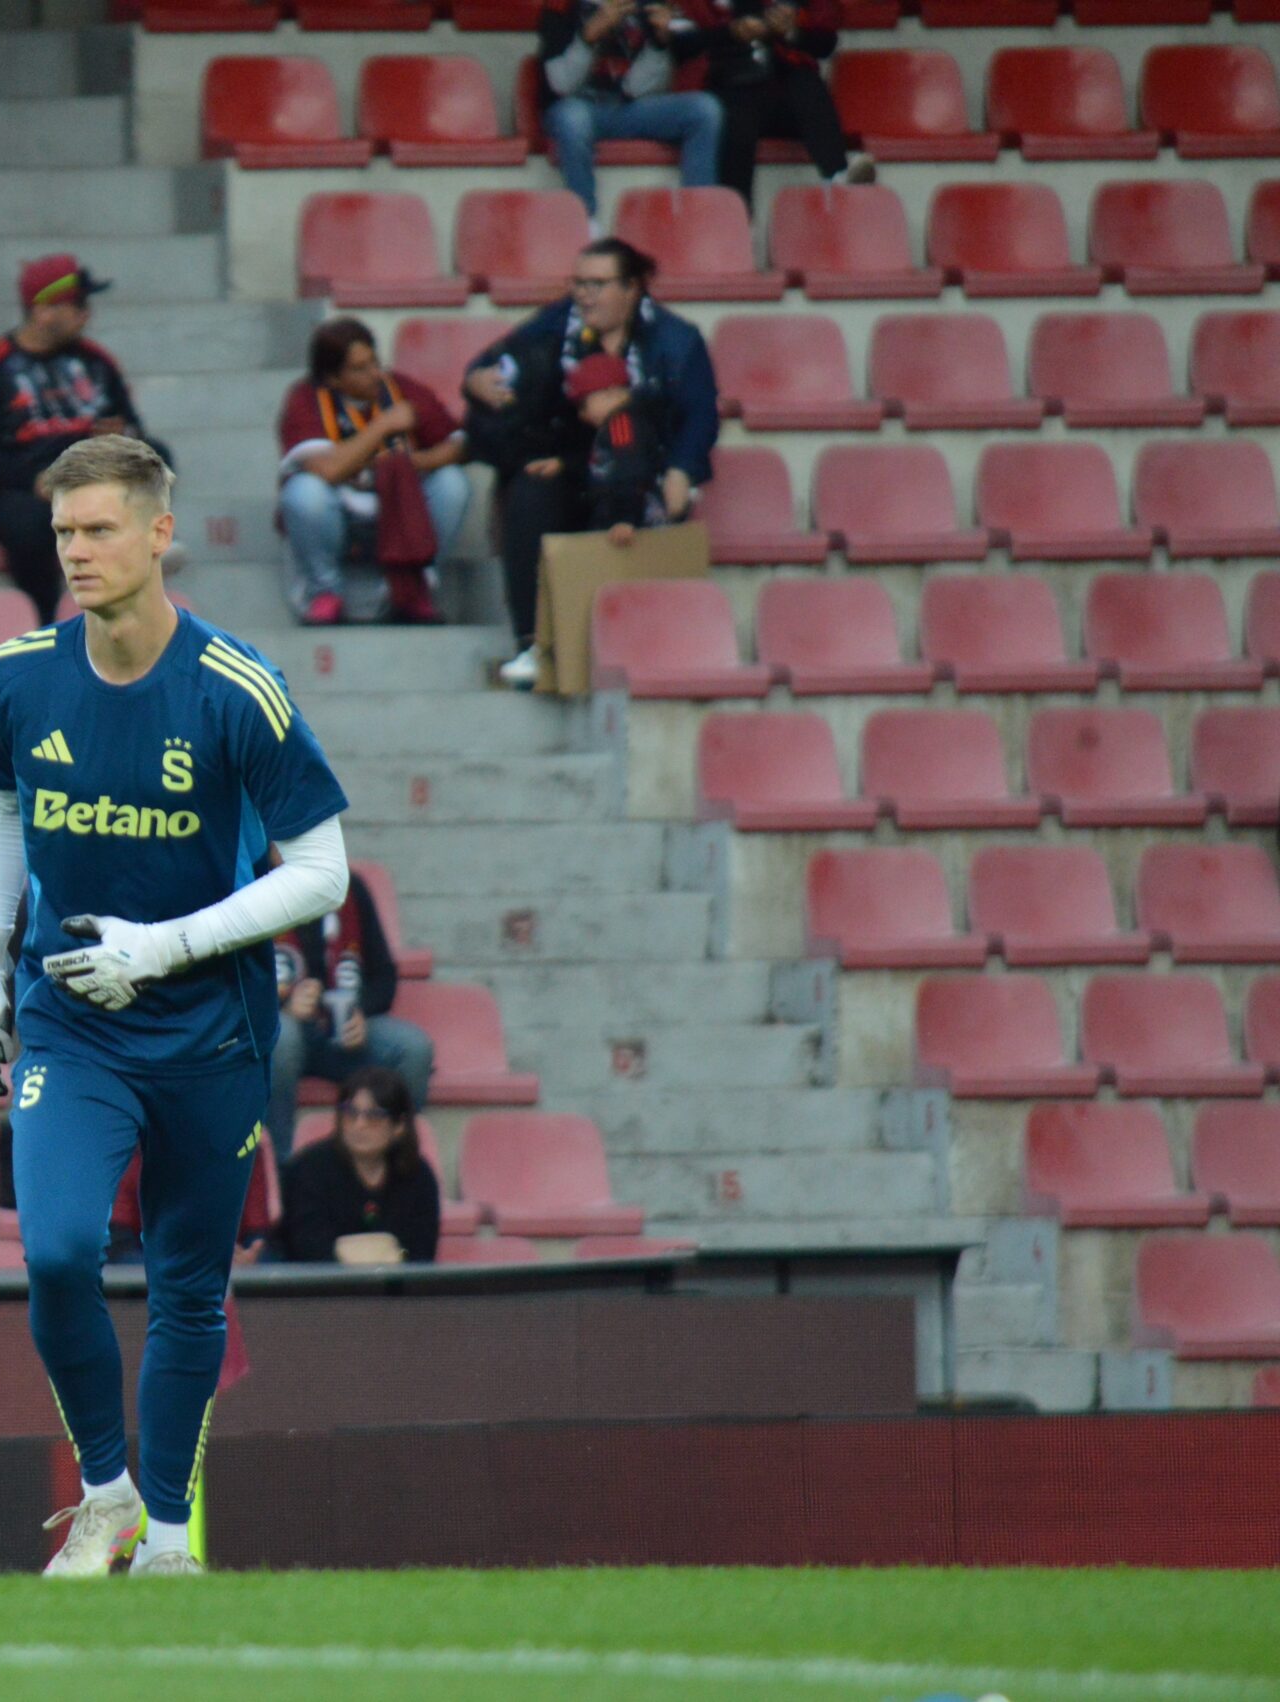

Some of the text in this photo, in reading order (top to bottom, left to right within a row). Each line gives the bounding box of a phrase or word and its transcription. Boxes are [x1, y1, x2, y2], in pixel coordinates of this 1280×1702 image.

[161, 748, 194, 792] S
[33, 787, 201, 839] Betano
[46, 951, 92, 970] reusch
[18, 1073, 45, 1110] S
